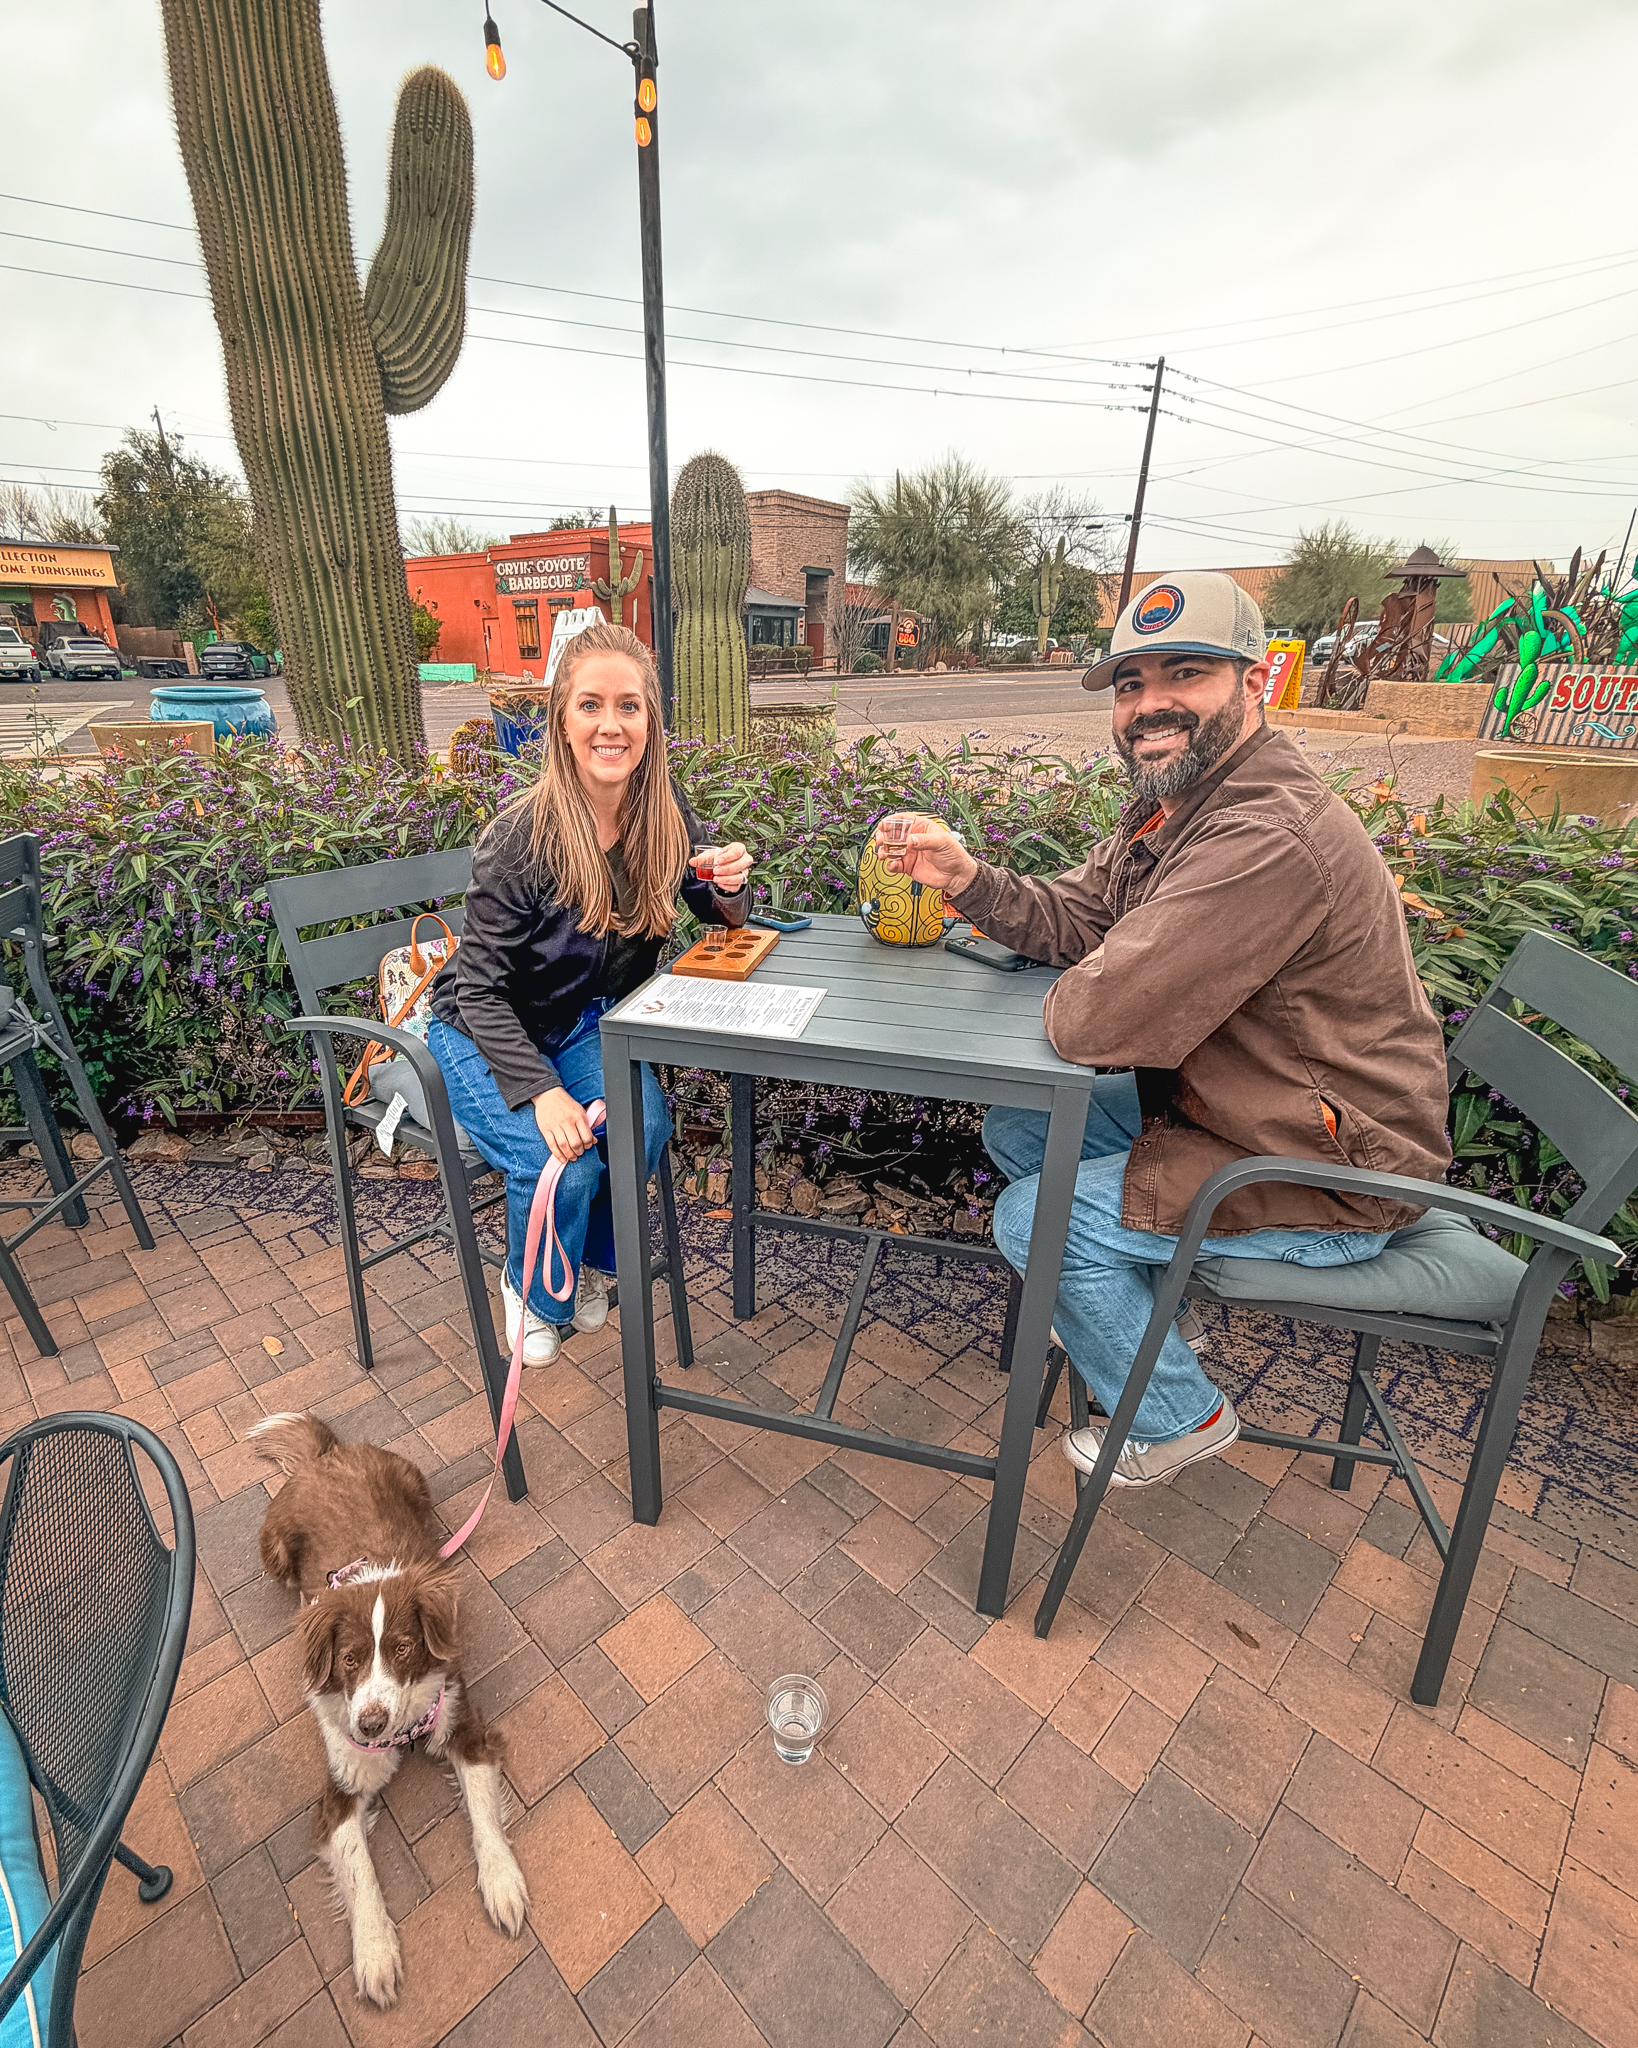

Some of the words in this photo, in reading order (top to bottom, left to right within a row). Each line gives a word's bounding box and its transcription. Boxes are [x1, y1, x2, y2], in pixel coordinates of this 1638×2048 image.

[0, 551, 57, 563] LLECTION
[536, 557, 586, 573] COYOTE
[0, 563, 27, 574] OME
[31, 565, 106, 578] FURNISHINGS
[508, 574, 573, 591] BARBECUE
[898, 632, 916, 645] BBQ
[1263, 652, 1287, 704] OPEN
[1548, 672, 1638, 714] SOUT
